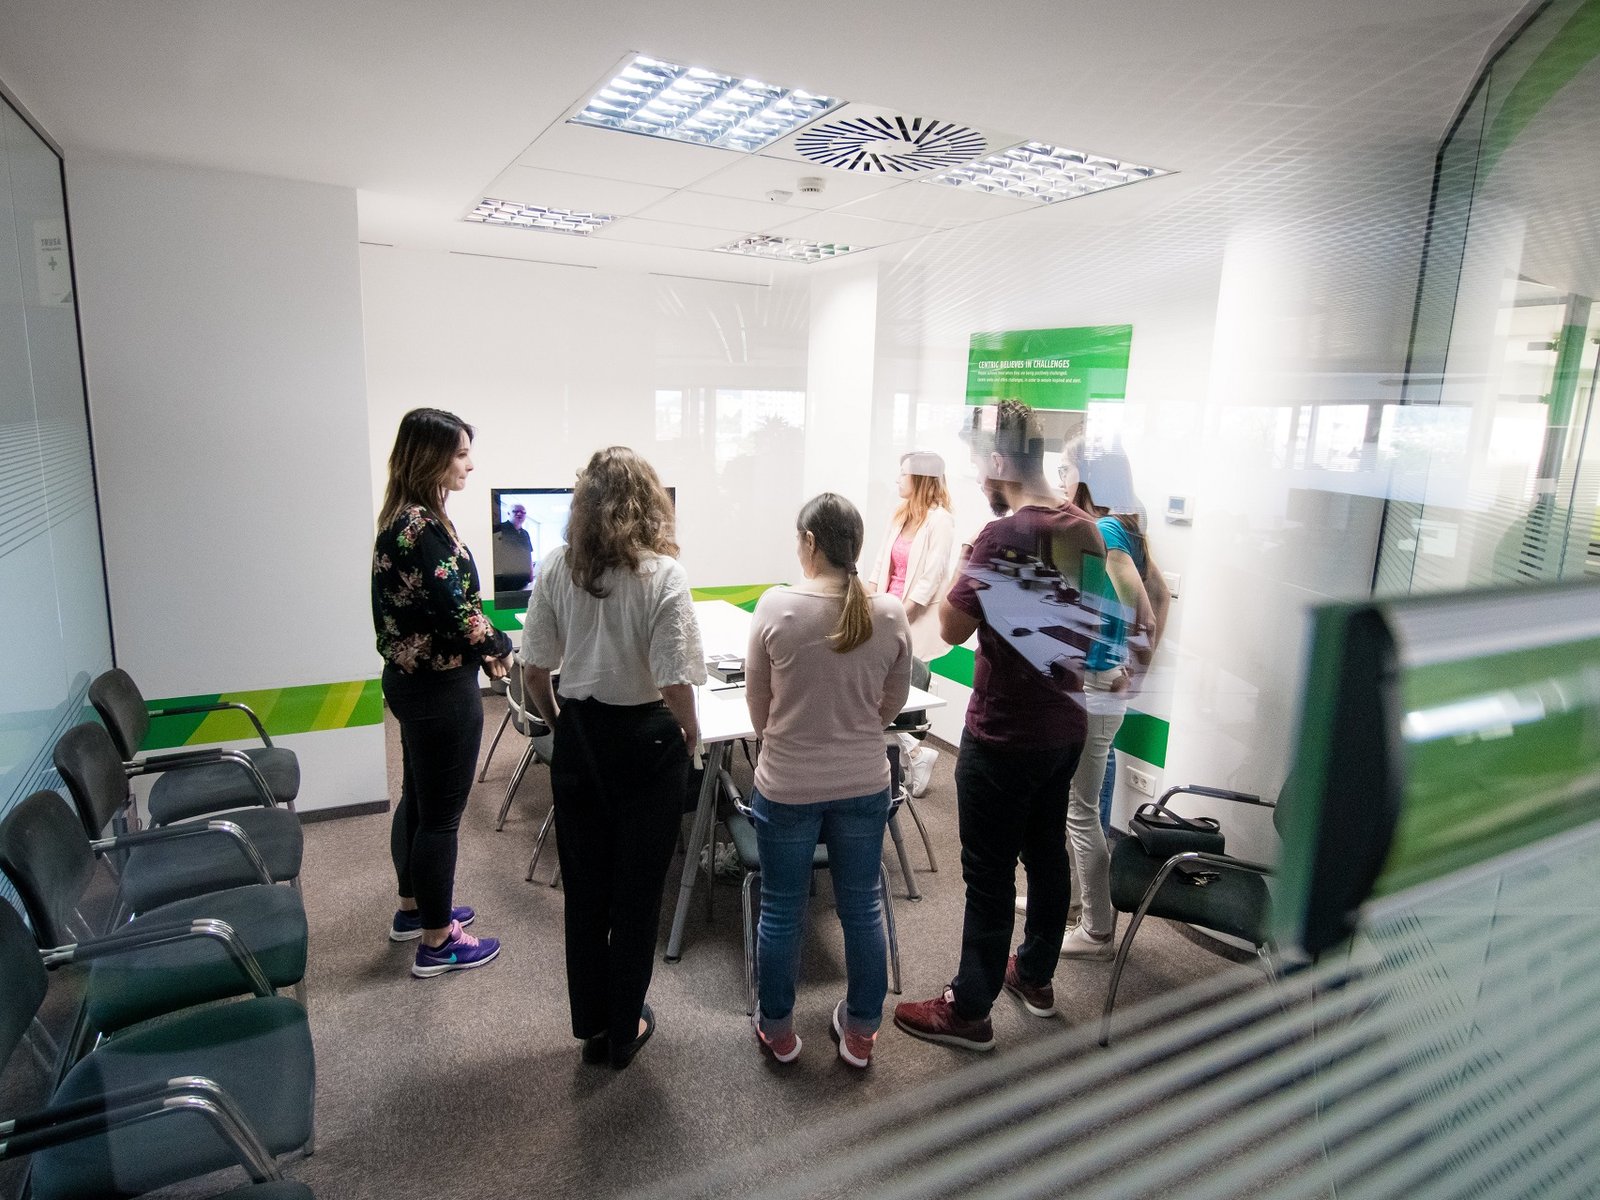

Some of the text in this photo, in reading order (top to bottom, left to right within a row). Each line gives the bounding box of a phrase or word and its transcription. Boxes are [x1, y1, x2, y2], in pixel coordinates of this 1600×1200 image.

[978, 359, 1070, 369] CENTRIC BELIEVES IN CHALLENGES
